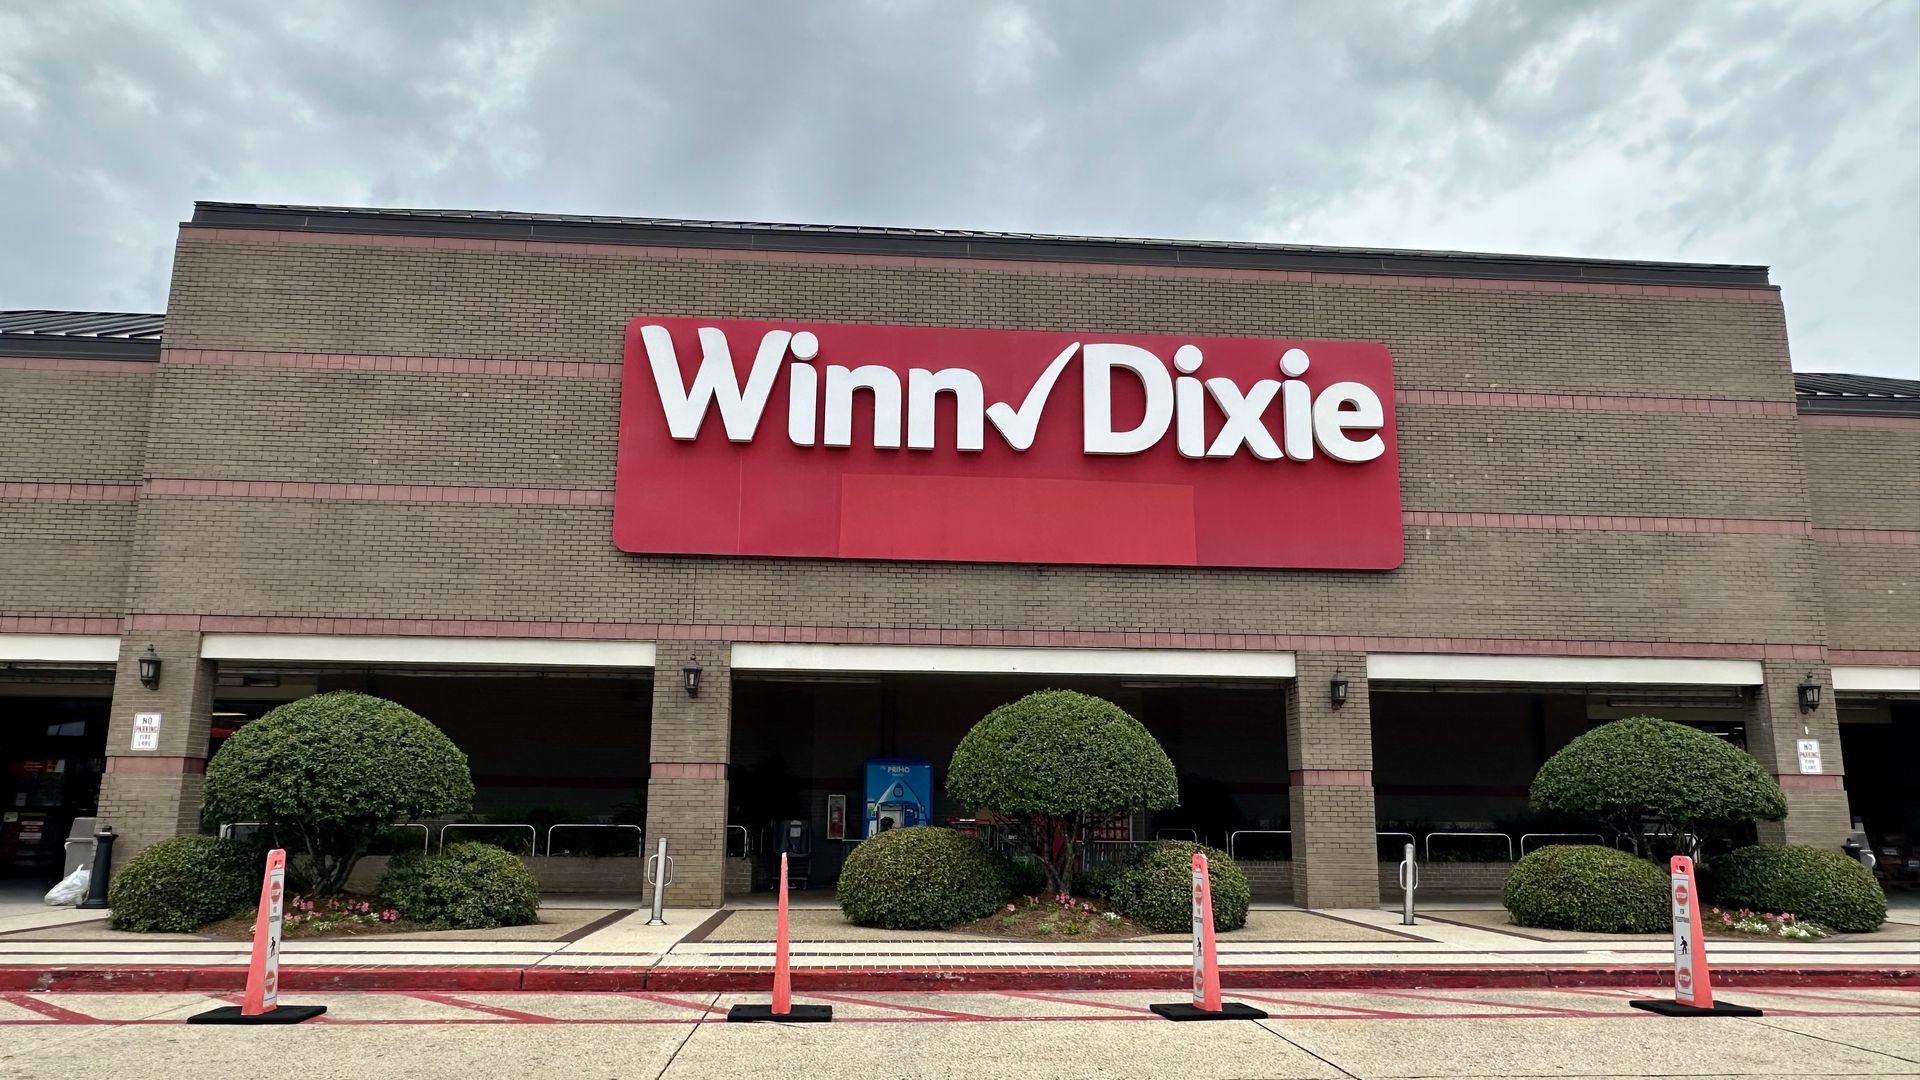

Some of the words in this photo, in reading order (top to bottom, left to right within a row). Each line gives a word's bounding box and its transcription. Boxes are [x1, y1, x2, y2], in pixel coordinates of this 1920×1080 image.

[640, 325, 985, 450] Winn
[1082, 343, 1386, 464] Dixie
[142, 717, 153, 725] NO
[1803, 743, 1813, 751] NO
